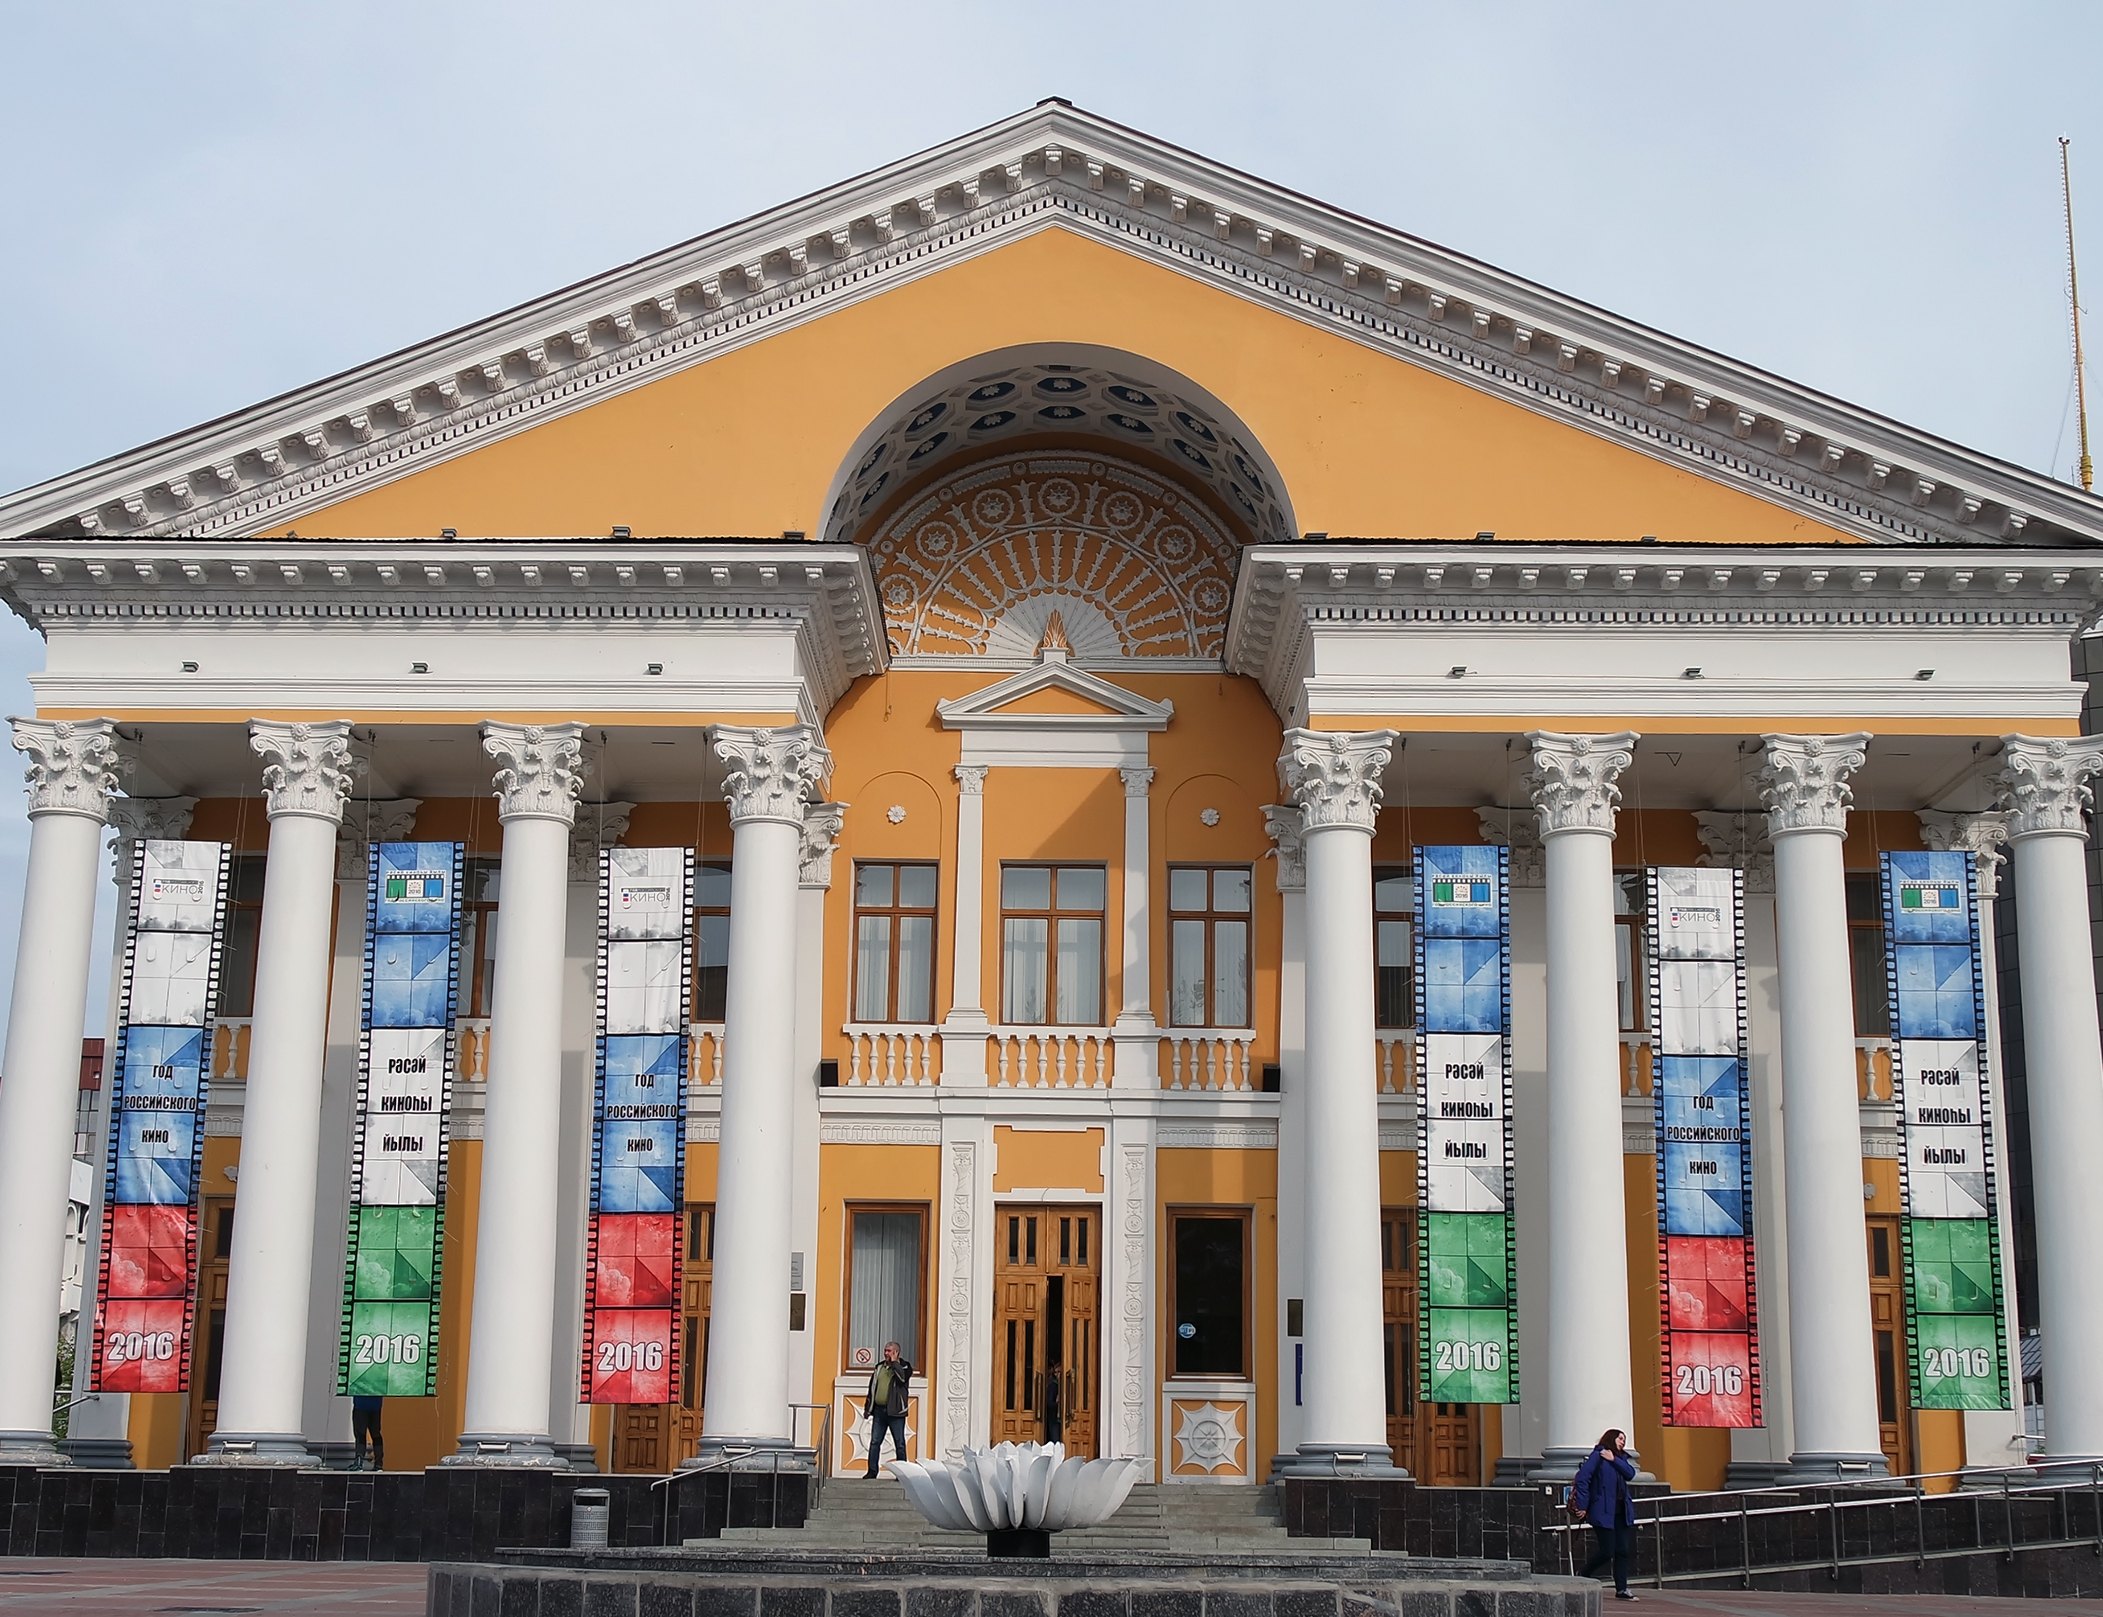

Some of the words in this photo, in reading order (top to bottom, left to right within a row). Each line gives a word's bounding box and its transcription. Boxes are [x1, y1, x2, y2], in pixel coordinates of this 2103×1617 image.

[162, 885, 198, 894] КИНО
[630, 892, 666, 902] КИНО
[1679, 912, 1715, 922] КИНО
[152, 1064, 174, 1081] ГОД
[634, 1073, 655, 1090] ГОД
[124, 1093, 196, 1110] РОССИЙСКОГО
[606, 1101, 678, 1119] РОССИЙСКОГО
[1693, 1095, 1714, 1112] ГОД
[141, 1129, 169, 1144] КИНО
[1666, 1123, 1740, 1142] РОССИЙСКОГО
[382, 1133, 423, 1152] ЙЫЛЫ
[626, 1137, 654, 1153] КИНО
[1444, 1139, 1487, 1158] ЙЫЛЫ
[1923, 1145, 1966, 1164] ЙЫЛЫ
[1688, 1159, 1718, 1175] КИНО
[107, 1331, 174, 1361] 2016
[355, 1334, 422, 1364] 2016
[597, 1341, 664, 1371] 2016
[1435, 1340, 1502, 1371] 2016
[1924, 1347, 1991, 1377] 2016
[1676, 1364, 1743, 1395] 2016
